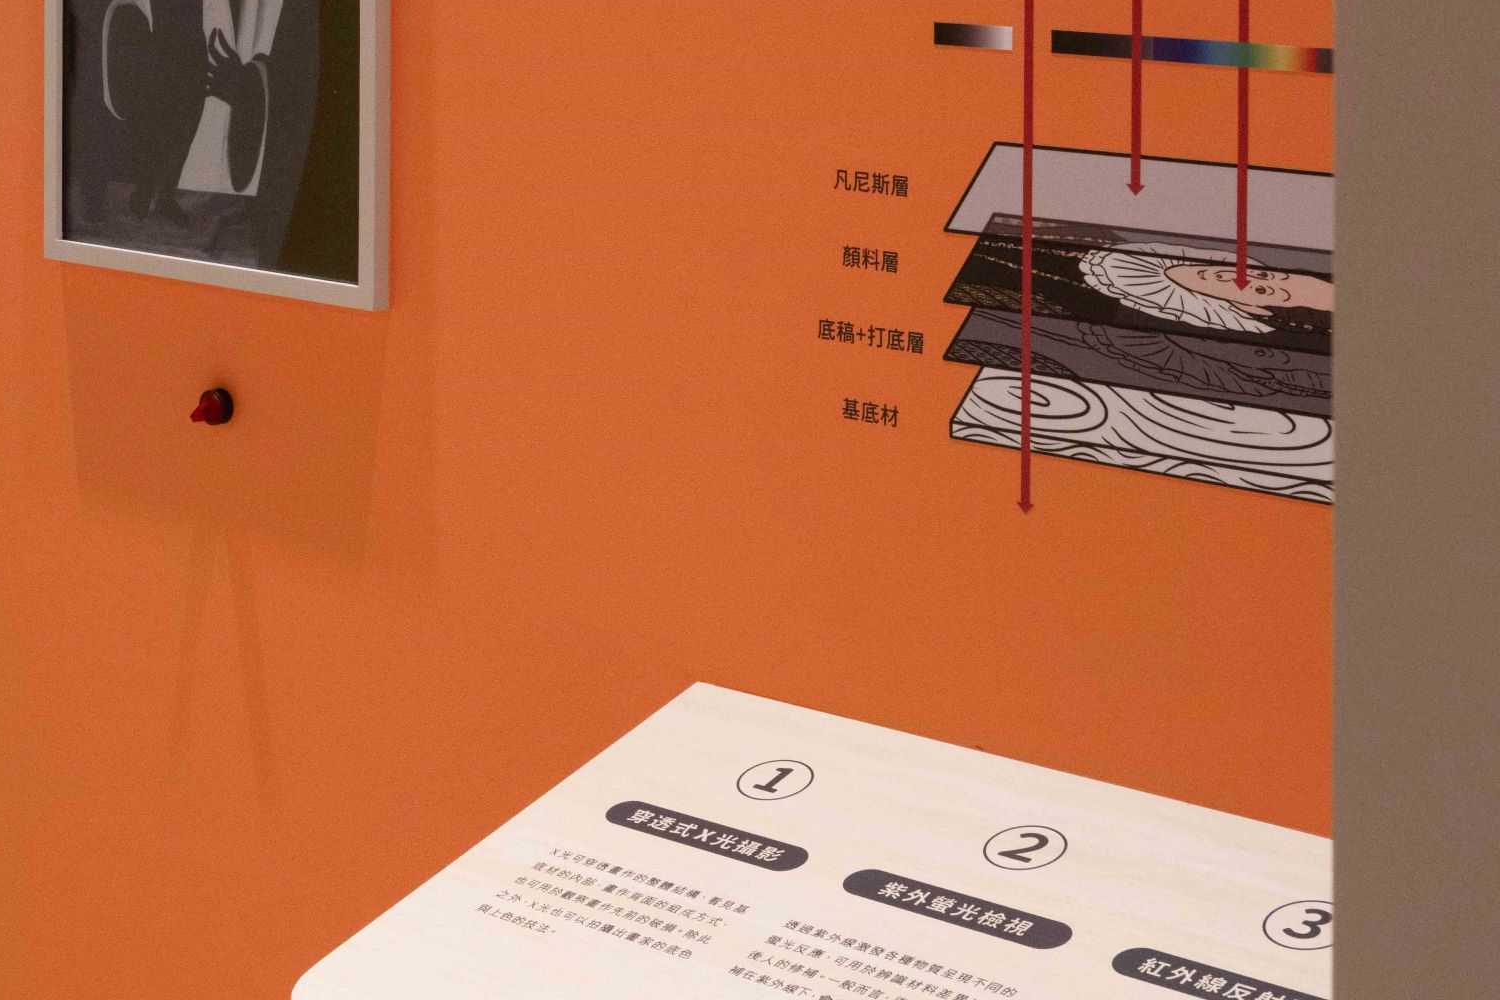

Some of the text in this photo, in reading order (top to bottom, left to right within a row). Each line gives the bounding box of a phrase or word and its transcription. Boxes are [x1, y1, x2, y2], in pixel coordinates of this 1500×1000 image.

[833, 168, 910, 198] 凡尼斯層
[842, 244, 899, 274] 顏料層
[841, 397, 899, 427] 基底材
[627, 808, 786, 863] 穿透式X光攝影
[878, 881, 1035, 938] 紫外螢光檢視
